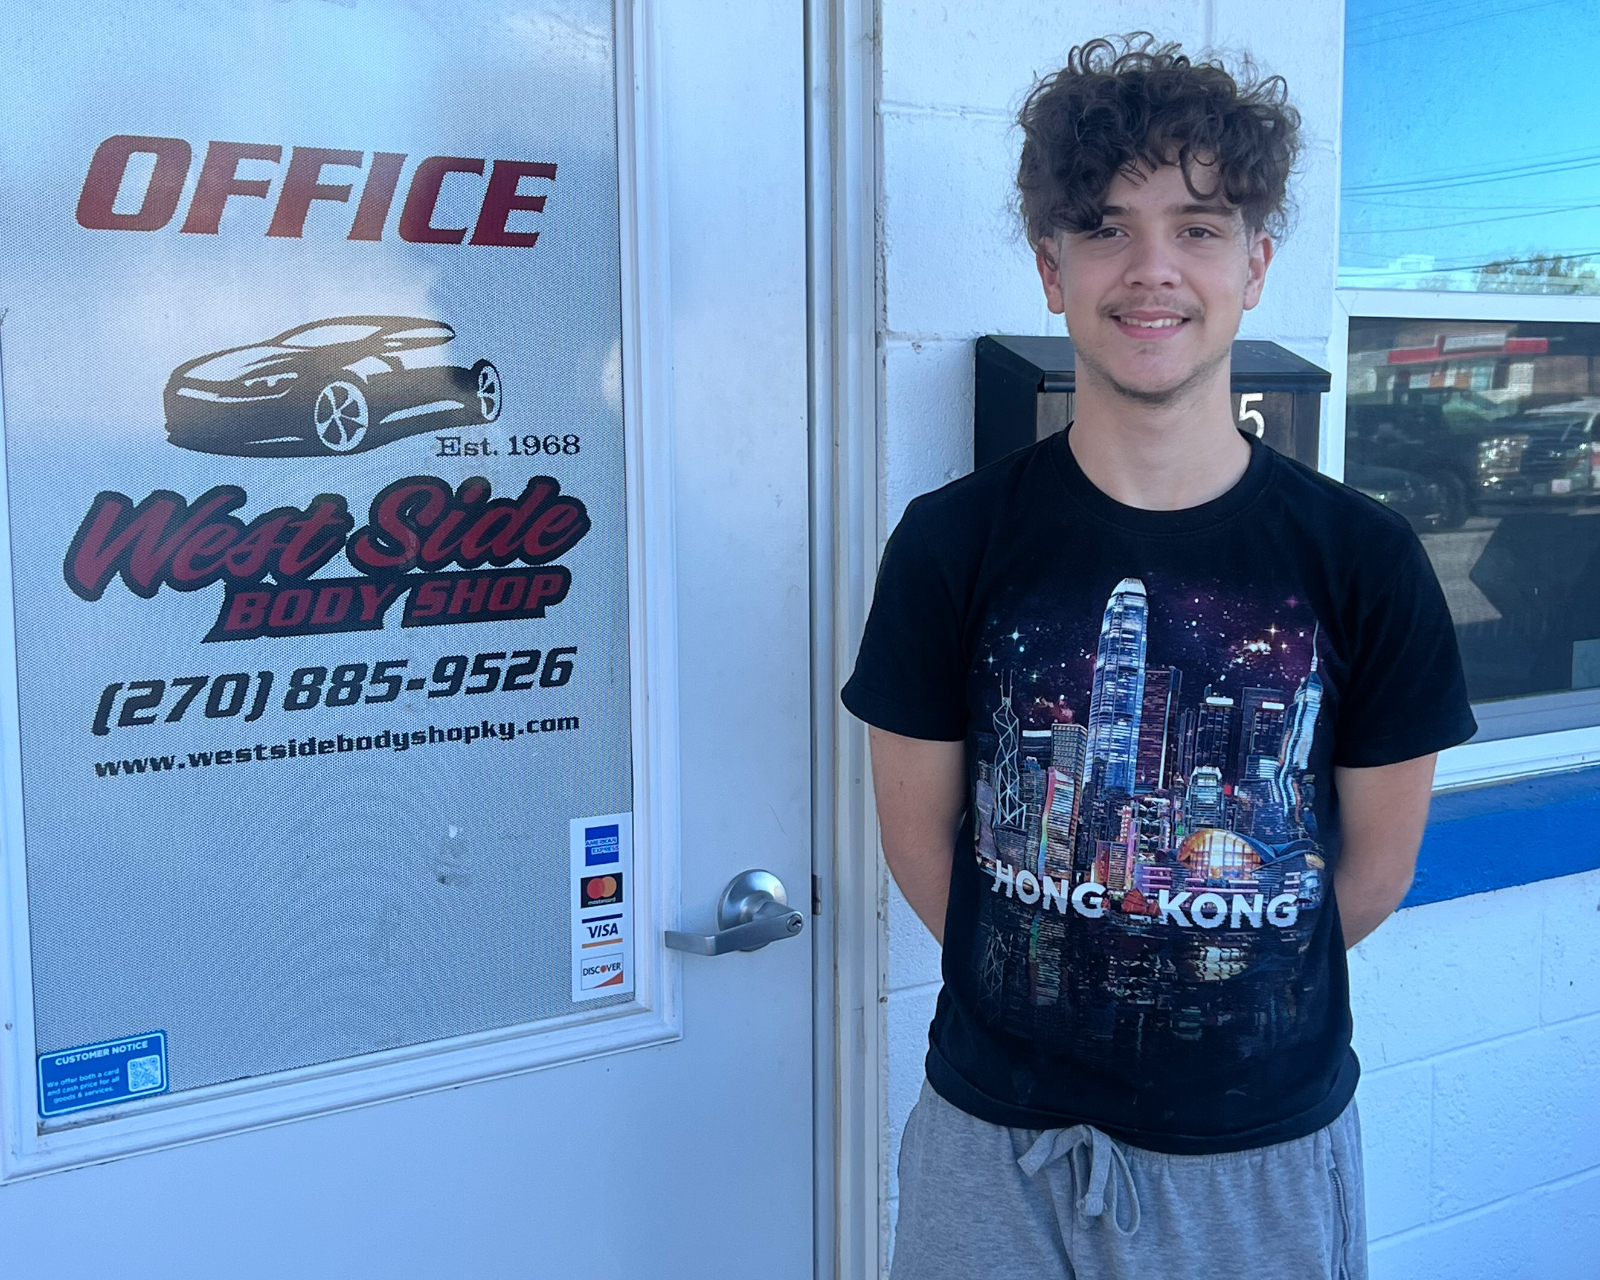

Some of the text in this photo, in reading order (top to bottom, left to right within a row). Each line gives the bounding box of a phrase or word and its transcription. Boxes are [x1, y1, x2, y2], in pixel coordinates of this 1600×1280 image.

[75, 134, 558, 248] OFFICE
[1239, 393, 1265, 438] 5
[436, 434, 581, 457] Est. 1968
[66, 477, 588, 599] West Side
[223, 573, 565, 632] BODY SHOP
[92, 646, 578, 736] (270) 885-9526
[95, 713, 580, 778] www.westsidebodyshopky.com
[585, 837, 617, 847] AMERICAN
[991, 859, 1299, 929] HONG KONG
[587, 922, 618, 938] VISA
[583, 962, 621, 976] DISCOVER
[55, 1040, 148, 1066] CUSTOMER NOTICE
[47, 1075, 120, 1097] and cash price for all
[60, 1077, 77, 1086] offer
[79, 1073, 96, 1082] both
[103, 1067, 120, 1077] card
[53, 1093, 76, 1105] goods
